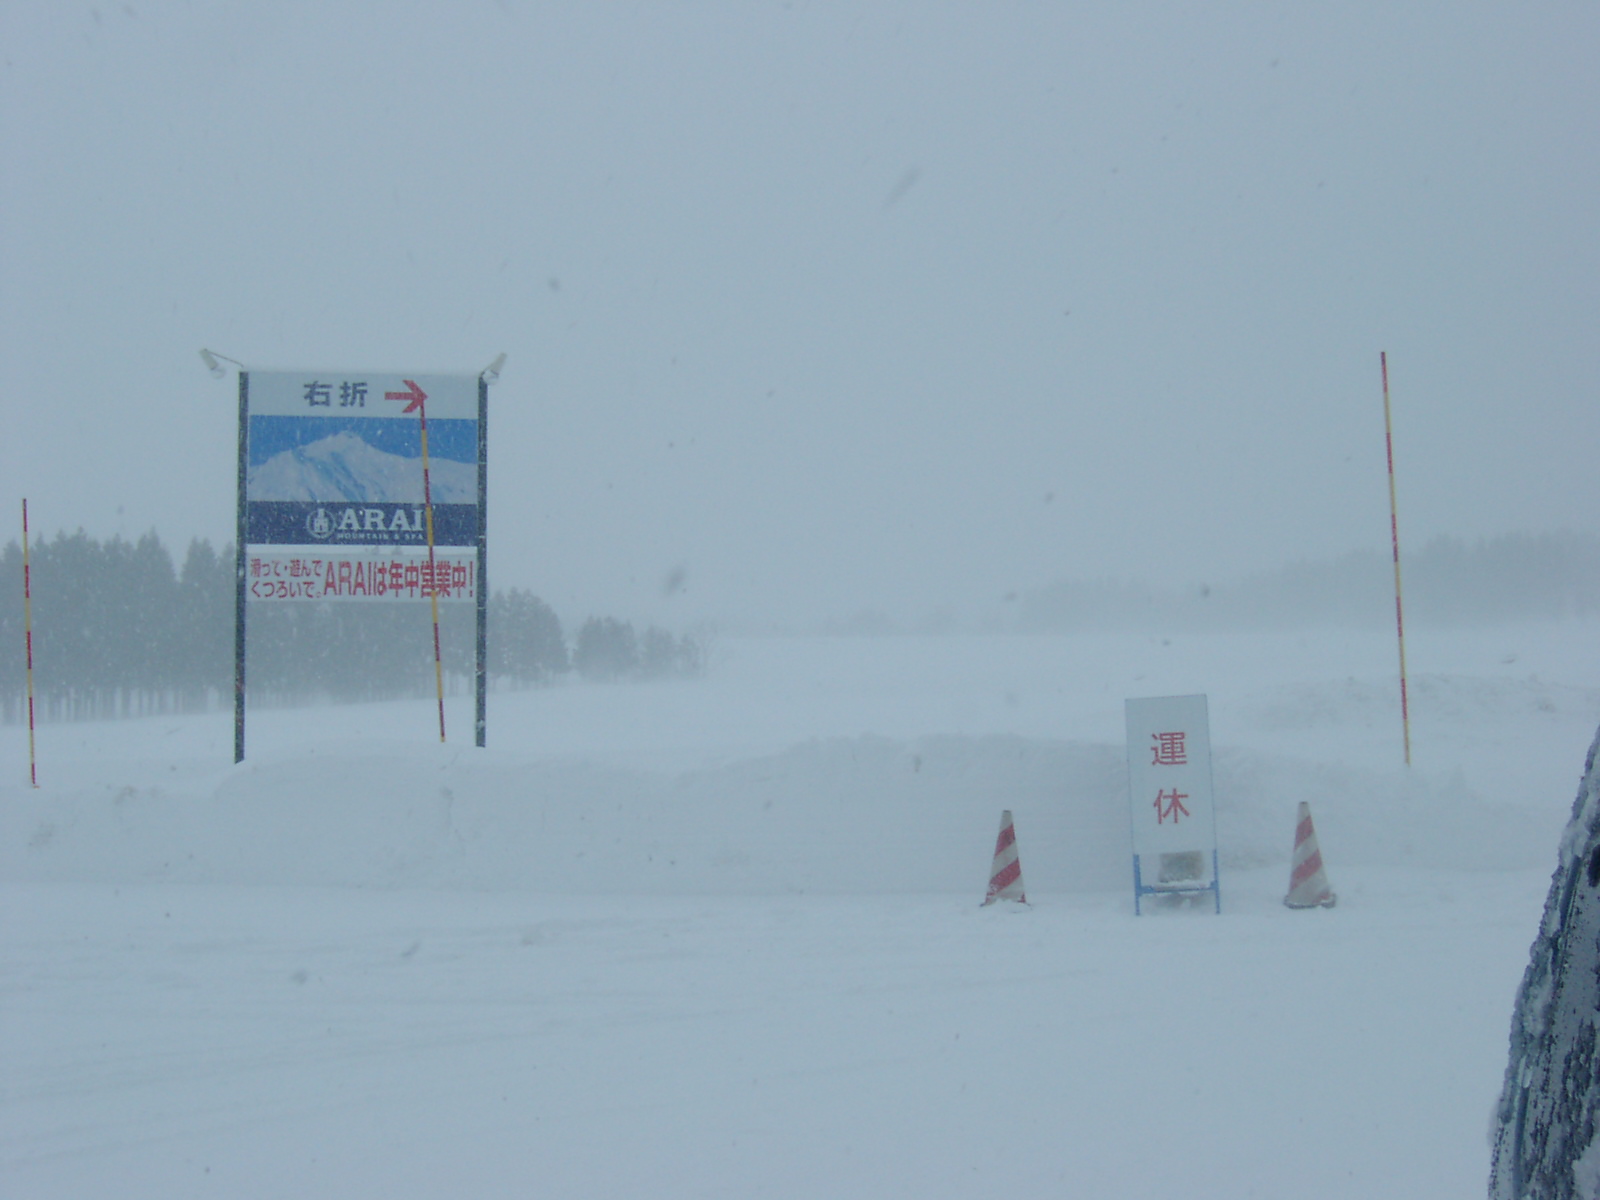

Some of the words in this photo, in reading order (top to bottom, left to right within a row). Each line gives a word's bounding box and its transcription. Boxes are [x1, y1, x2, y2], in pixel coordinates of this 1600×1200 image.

[303, 383, 368, 407] 右折
[337, 508, 425, 531] ARAI
[1151, 731, 1190, 825] 運休
